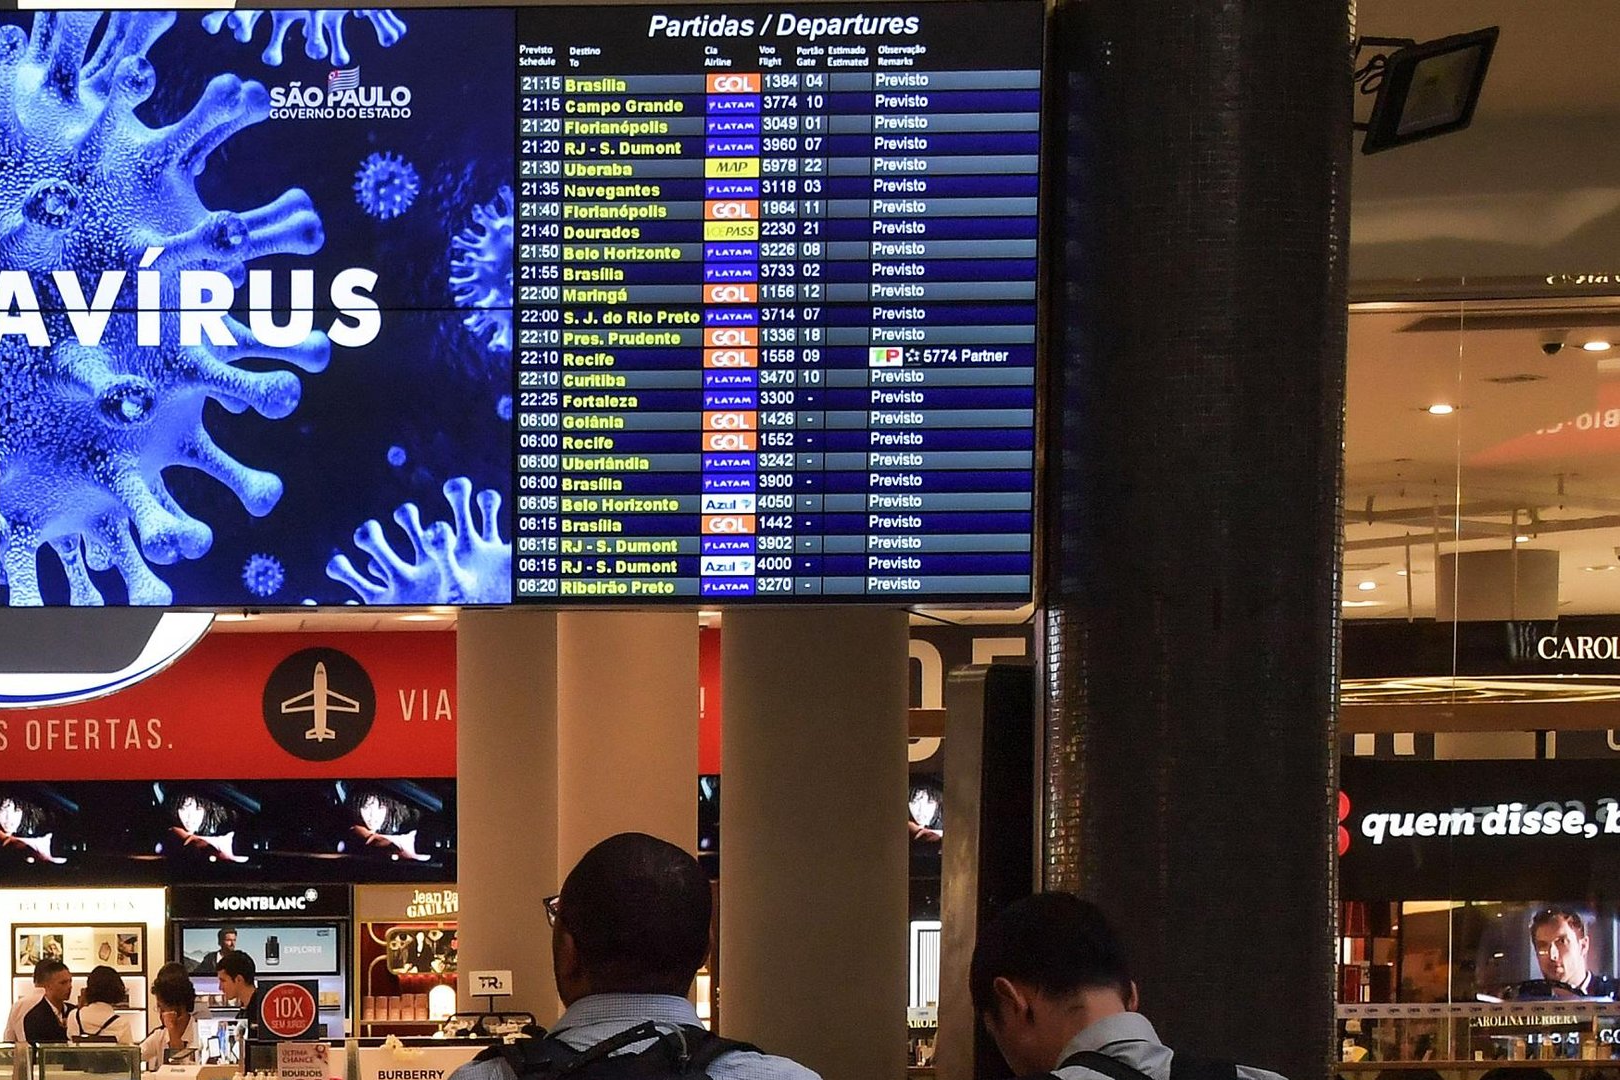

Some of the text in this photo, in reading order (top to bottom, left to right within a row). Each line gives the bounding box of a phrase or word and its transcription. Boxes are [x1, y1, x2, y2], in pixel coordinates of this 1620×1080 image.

[648, 13, 920, 42] Partidas / Departures
[270, 81, 411, 107] SÃO PAULO
[269, 108, 411, 119] GOVERNO DO ESTADO
[522, 93, 929, 116] 21:15 Campo Grande LATAM 3774 10 Previsto
[521, 157, 927, 177] 21:30 Uberaba MAP 5978 22 Previsto
[520, 350, 559, 365] 22:10
[563, 352, 615, 367] Recife
[711, 350, 751, 368] GOL
[761, 349, 795, 363] 1558
[802, 348, 820, 363] 09
[923, 349, 958, 363] 5774
[961, 348, 1009, 362] Partner
[519, 493, 922, 512] 06:05 Belo Horizonte Azul 4050 Previsto
[399, 688, 453, 721] VIA
[25, 718, 174, 751] OFERTAS.
[1362, 812, 1475, 844] quem
[1482, 803, 1598, 838] disse,
[214, 897, 306, 911] MONTBLANC
[413, 890, 442, 904] Jean
[283, 945, 322, 954] EXPLORER
[273, 997, 304, 1018] 10X
[378, 1070, 444, 1080] BURBERRY
